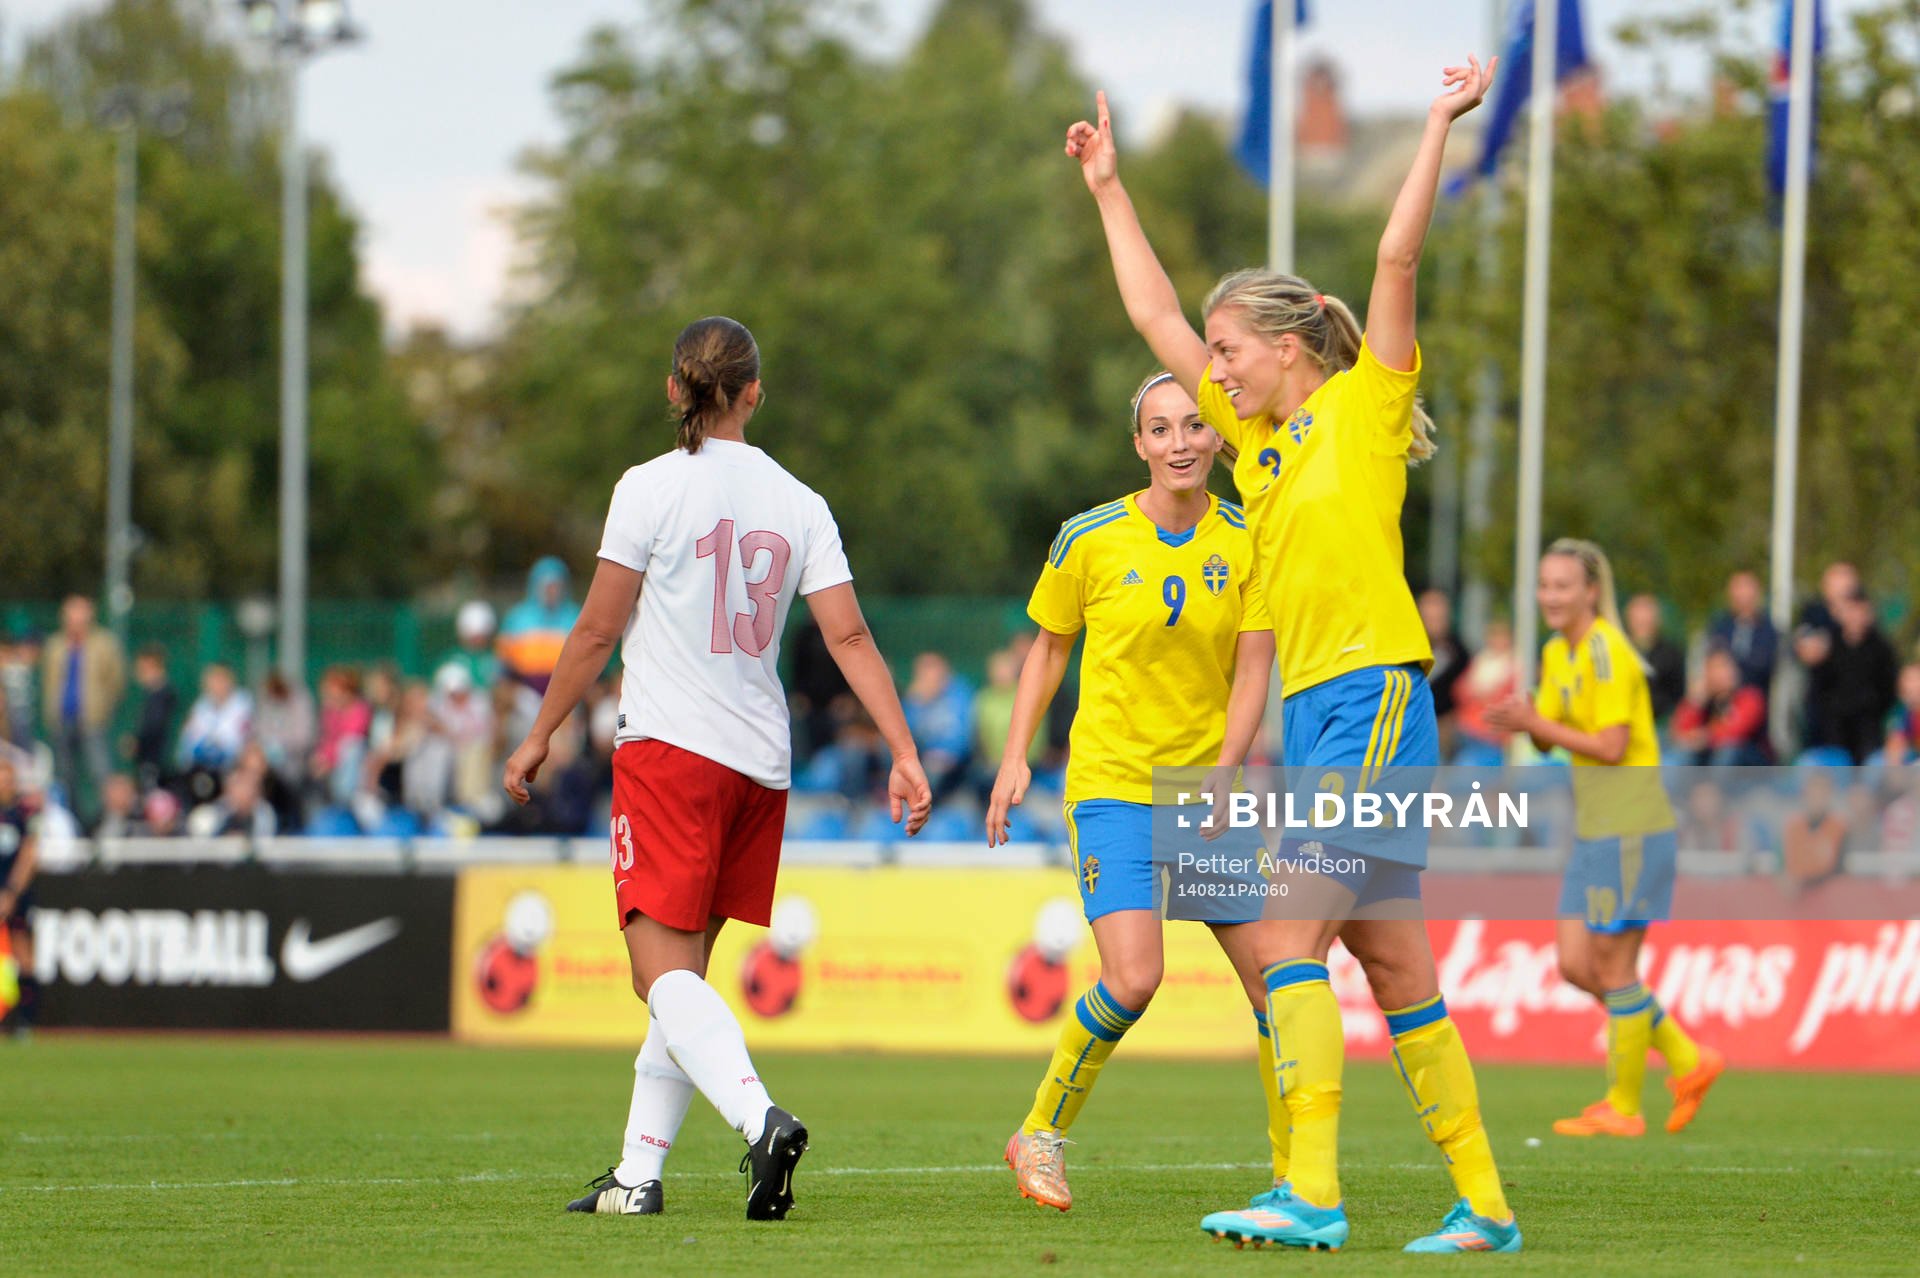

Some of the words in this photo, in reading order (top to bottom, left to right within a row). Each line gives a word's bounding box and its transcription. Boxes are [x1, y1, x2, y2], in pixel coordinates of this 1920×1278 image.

[696, 519, 791, 658] 13
[1163, 575, 1186, 627] 9
[33, 907, 275, 986] FOOTBALL
[1656, 943, 1796, 1027] nas
